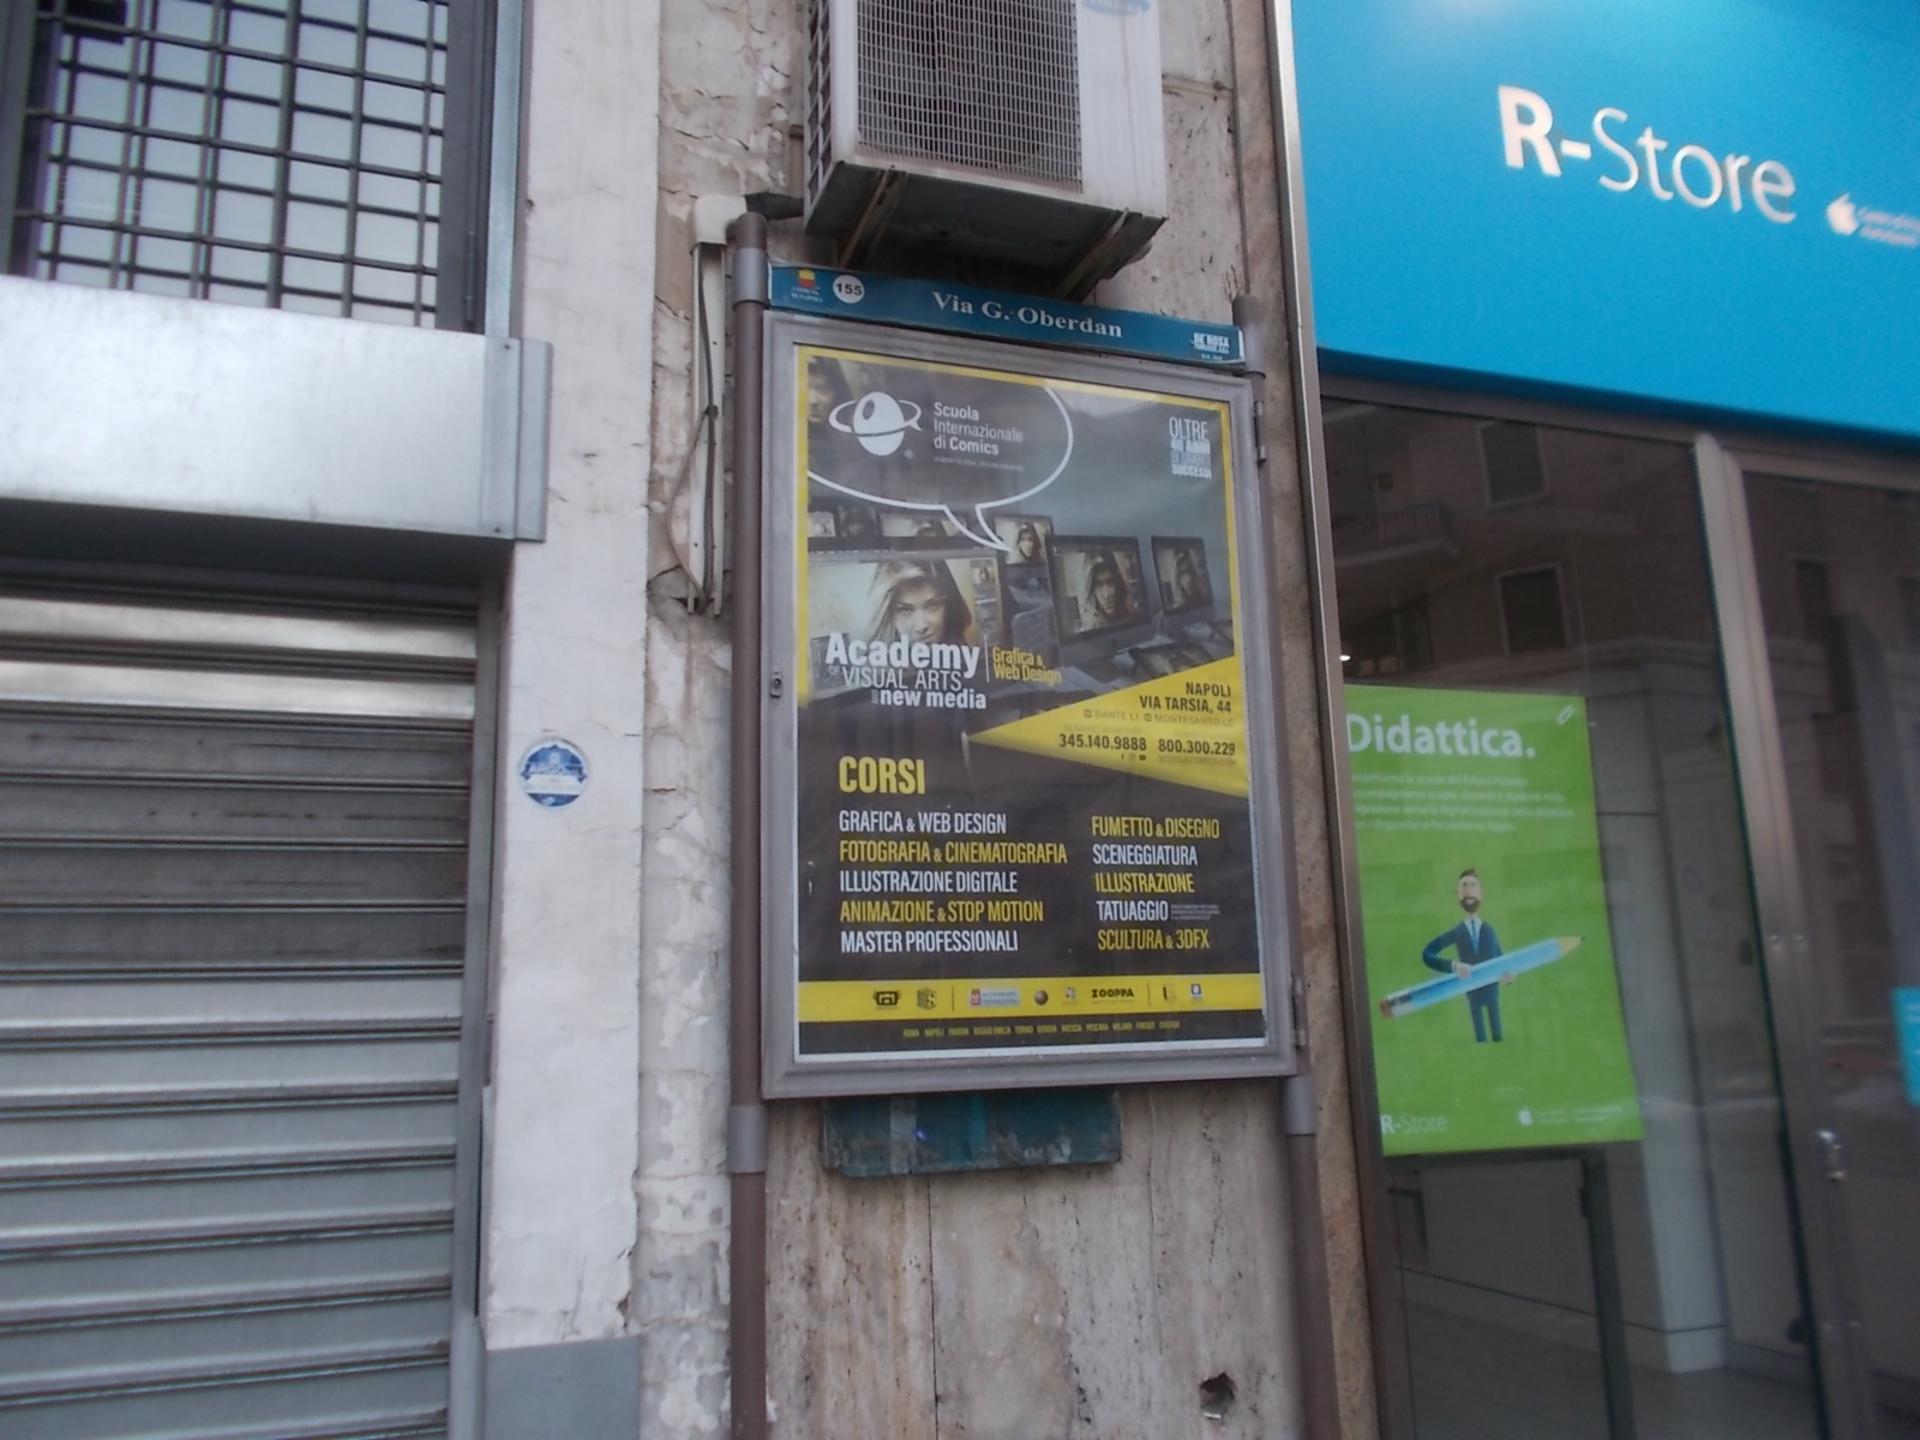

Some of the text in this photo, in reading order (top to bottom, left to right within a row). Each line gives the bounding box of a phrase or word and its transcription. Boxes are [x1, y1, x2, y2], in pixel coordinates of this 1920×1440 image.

[1498, 85, 1797, 224] R-Store
[836, 283, 862, 296] 155
[933, 291, 1123, 338] Via G. Oberdan
[934, 401, 980, 421] Scuola
[934, 418, 1024, 442] Internazionale
[1169, 416, 1208, 440] OLTRE
[934, 435, 999, 455] di Comics
[826, 632, 980, 679] Academy
[992, 646, 1035, 666] Grafica
[843, 666, 909, 689] VISUAL
[915, 670, 962, 692] ARTS
[993, 663, 1063, 686] Web Design
[880, 689, 921, 706] new
[926, 688, 987, 709] media
[1185, 682, 1231, 697] NAPOLI
[1139, 696, 1231, 714] VIA TARSIA, 44
[1059, 733, 1236, 756] 345.140.9888 800.300.229
[1348, 714, 1537, 758] Didattica.
[839, 756, 925, 795] CORSI
[839, 810, 1007, 835] GRAFICA & WEB DESIGN
[1091, 815, 1220, 839] FUMETTO & DISEGNO
[839, 840, 1068, 864] FOTOGRAFIA & CINEMATOGRAFIA
[1092, 843, 1199, 866] SCENEGGIATURA
[840, 870, 1018, 893] ILLUSTRAZIONE DIGITALE
[1095, 872, 1195, 893] ILLUSTRAZIONE
[840, 900, 1044, 923] ANIMAZIONE & STOP MOTION
[1096, 900, 1169, 921] TATUAGGIO
[841, 929, 1018, 954] MASTER PROFESSIONALI
[1097, 928, 1211, 950] SCULTURA & 3DFX
[1091, 987, 1134, 999] ZOOPPA
[1381, 1113, 1449, 1135] R-Store
